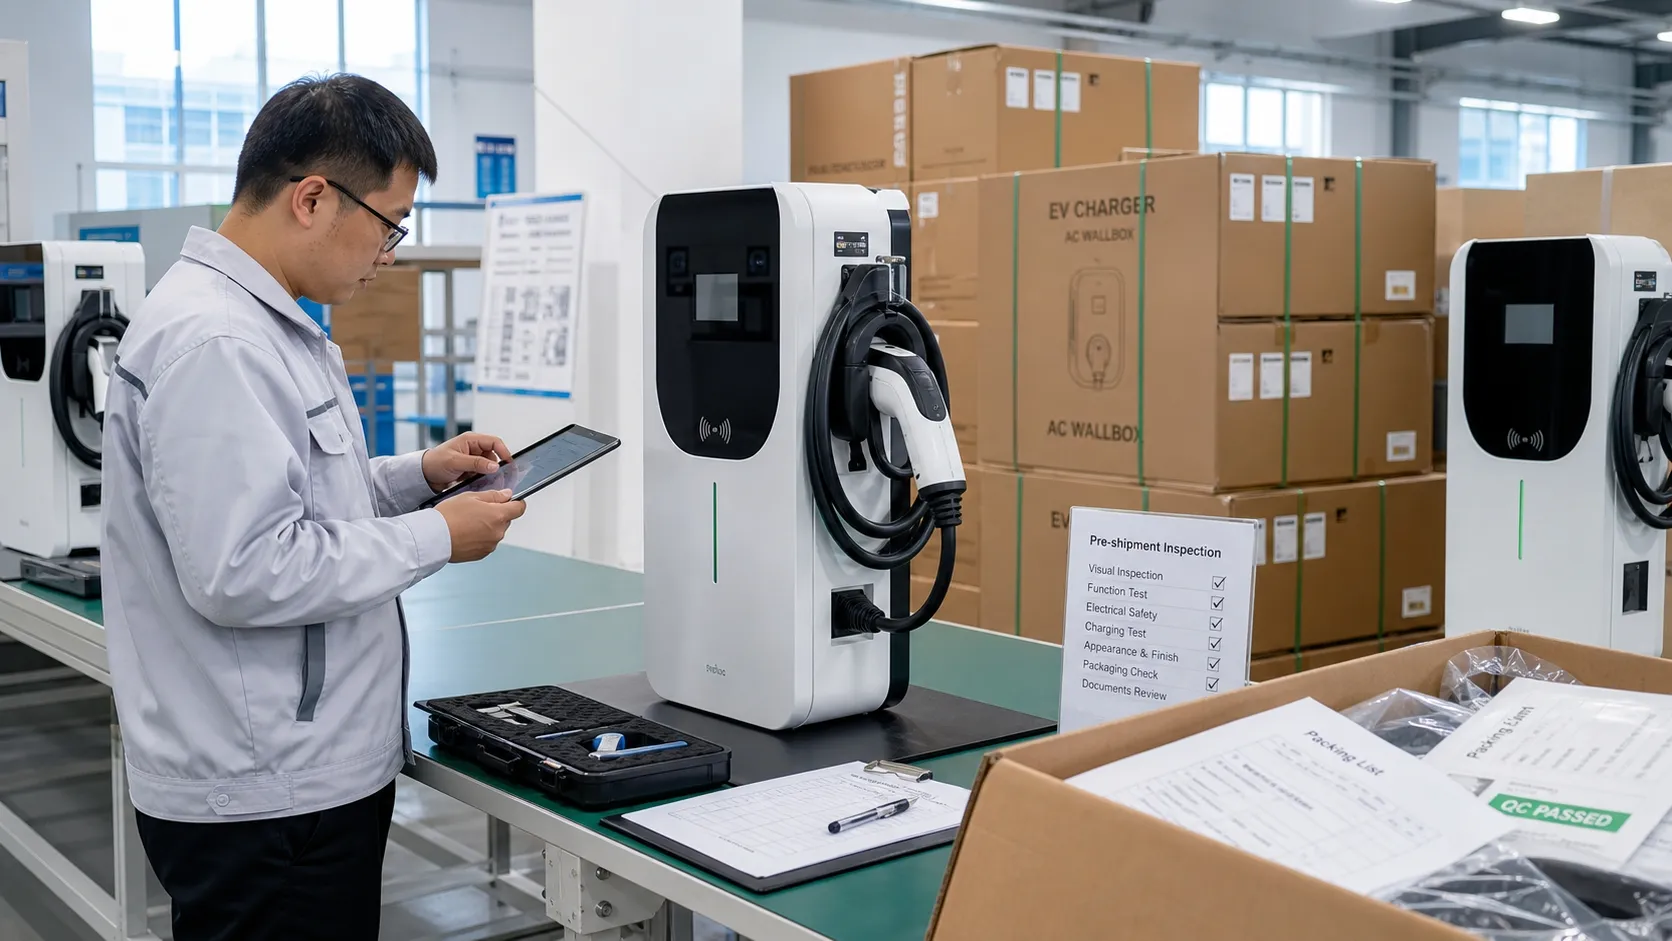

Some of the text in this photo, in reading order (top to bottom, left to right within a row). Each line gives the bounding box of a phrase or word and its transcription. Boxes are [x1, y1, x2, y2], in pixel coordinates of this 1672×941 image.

[1049, 195, 1155, 219] EV CHARGER
[1065, 227, 1134, 243] AC WALLBOX
[1047, 419, 1067, 437] AC
[1051, 510, 1069, 529] EV
[1089, 534, 1222, 558] Pre-shipment Inspection
[1088, 563, 1164, 581] Visual Inspection
[1087, 582, 1148, 600] Function Test
[1086, 602, 1158, 622] Electrical Safety
[1085, 621, 1147, 639] Charging Test
[1083, 641, 1179, 663] Appearance & Finish
[1083, 659, 1158, 680] Packaging Check
[1082, 678, 1167, 701] Documents Review
[1303, 730, 1385, 776] Packing List
[1466, 727, 1514, 760] Packing
[1500, 799, 1613, 827] QC PASSED
